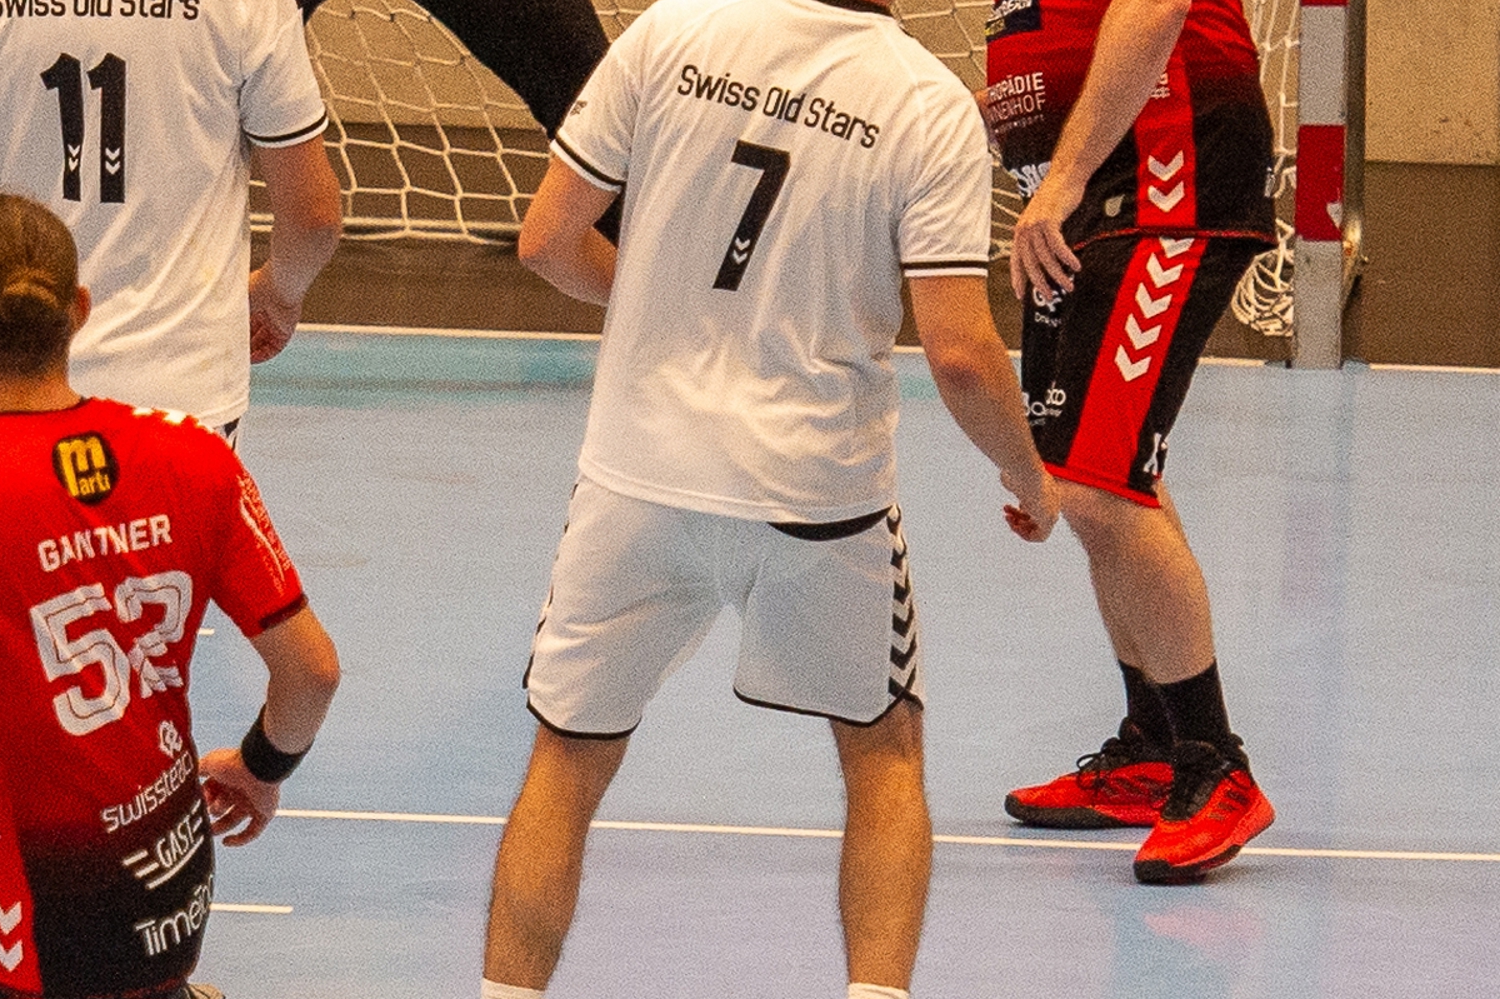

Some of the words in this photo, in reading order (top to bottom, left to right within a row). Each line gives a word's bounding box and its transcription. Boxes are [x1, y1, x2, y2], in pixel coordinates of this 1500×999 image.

[40, 52, 127, 203] 11
[677, 64, 760, 111] Swiss
[763, 86, 803, 122] Old
[804, 97, 880, 149] Stars
[712, 139, 791, 292] 7
[37, 513, 173, 573] GANTNER
[29, 570, 194, 737] 52
